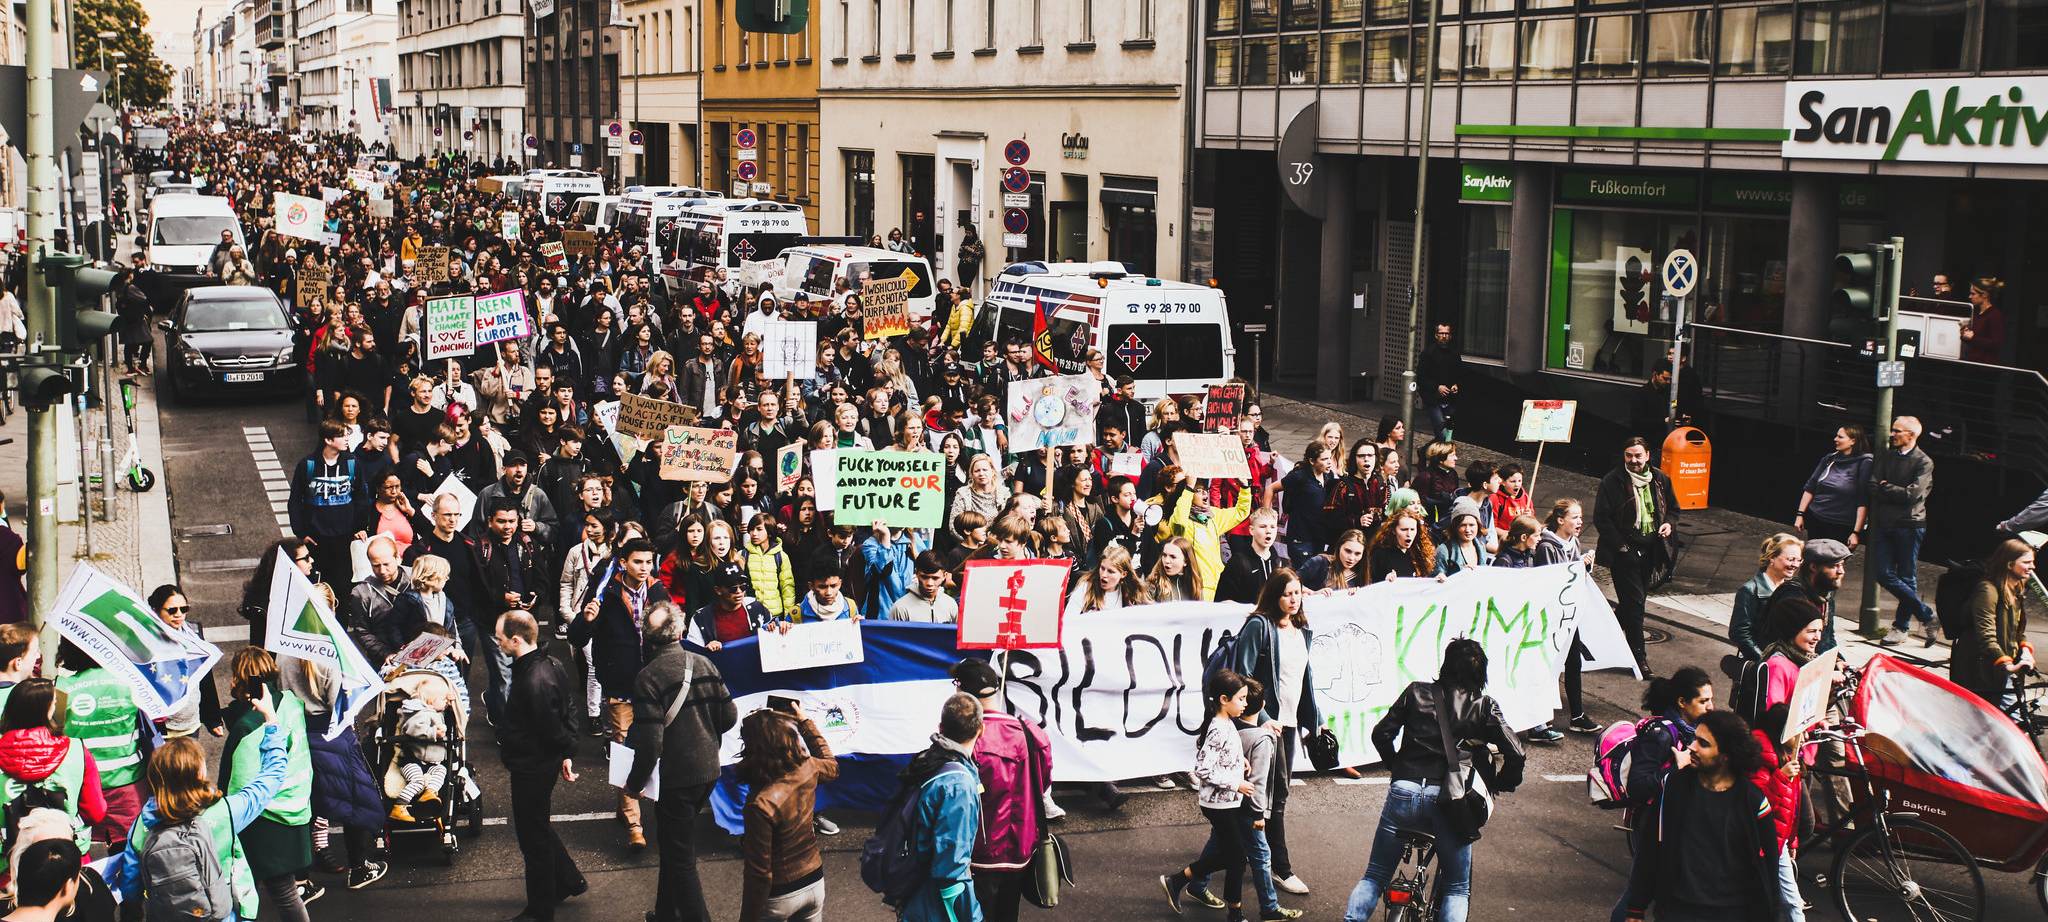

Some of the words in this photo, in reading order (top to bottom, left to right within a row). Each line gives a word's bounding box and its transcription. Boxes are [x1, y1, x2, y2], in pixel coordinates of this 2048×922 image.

[1794, 86, 2048, 160] SanAktiv
[1062, 132, 1089, 149] CouCou
[1290, 162, 1313, 185] 39
[1463, 174, 1512, 193] SanAktiv
[1590, 179, 1666, 196] Fußkomfort
[751, 219, 761, 227] 99
[762, 219, 771, 227] 28
[771, 219, 780, 227] 79
[780, 219, 790, 227] 00
[867, 282, 884, 295] WISH
[886, 279, 908, 292] COULD
[430, 298, 467, 314] HATE
[477, 296, 512, 313] REEN
[864, 295, 874, 307] BE
[875, 295, 886, 305] AS
[885, 293, 899, 304] HOT
[899, 291, 908, 302] AS
[864, 306, 879, 318] OUR
[878, 303, 904, 317] PLANET
[1144, 303, 1156, 313] 99
[1159, 303, 1172, 313] 28
[1174, 303, 1186, 313] 79
[1188, 303, 1201, 313] 00
[429, 312, 471, 325] CLIMATE
[434, 321, 467, 332] CHANGE
[476, 317, 495, 329] EW
[496, 311, 522, 325] DEAL
[432, 341, 473, 354] DANCING!
[619, 403, 633, 414] TO
[634, 409, 655, 420] ACT
[655, 414, 668, 422] AS
[669, 415, 678, 423] IF
[678, 416, 694, 426] THE
[629, 397, 633, 405] I
[636, 399, 666, 411] WANT
[668, 404, 687, 415] YOU
[618, 414, 644, 429] HOUSE
[646, 420, 655, 429] IS
[838, 456, 874, 473] FUCK
[876, 459, 942, 473] YOURSELF
[1221, 449, 1245, 464] YOU
[836, 477, 867, 488] AND
[868, 477, 897, 488] NOT
[900, 474, 942, 493] OUR
[842, 491, 921, 512] FUTURE
[60, 616, 162, 715] www.europa-union.de
[997, 628, 1214, 742] BILDU
[1902, 800, 1947, 817] Bakfiets
